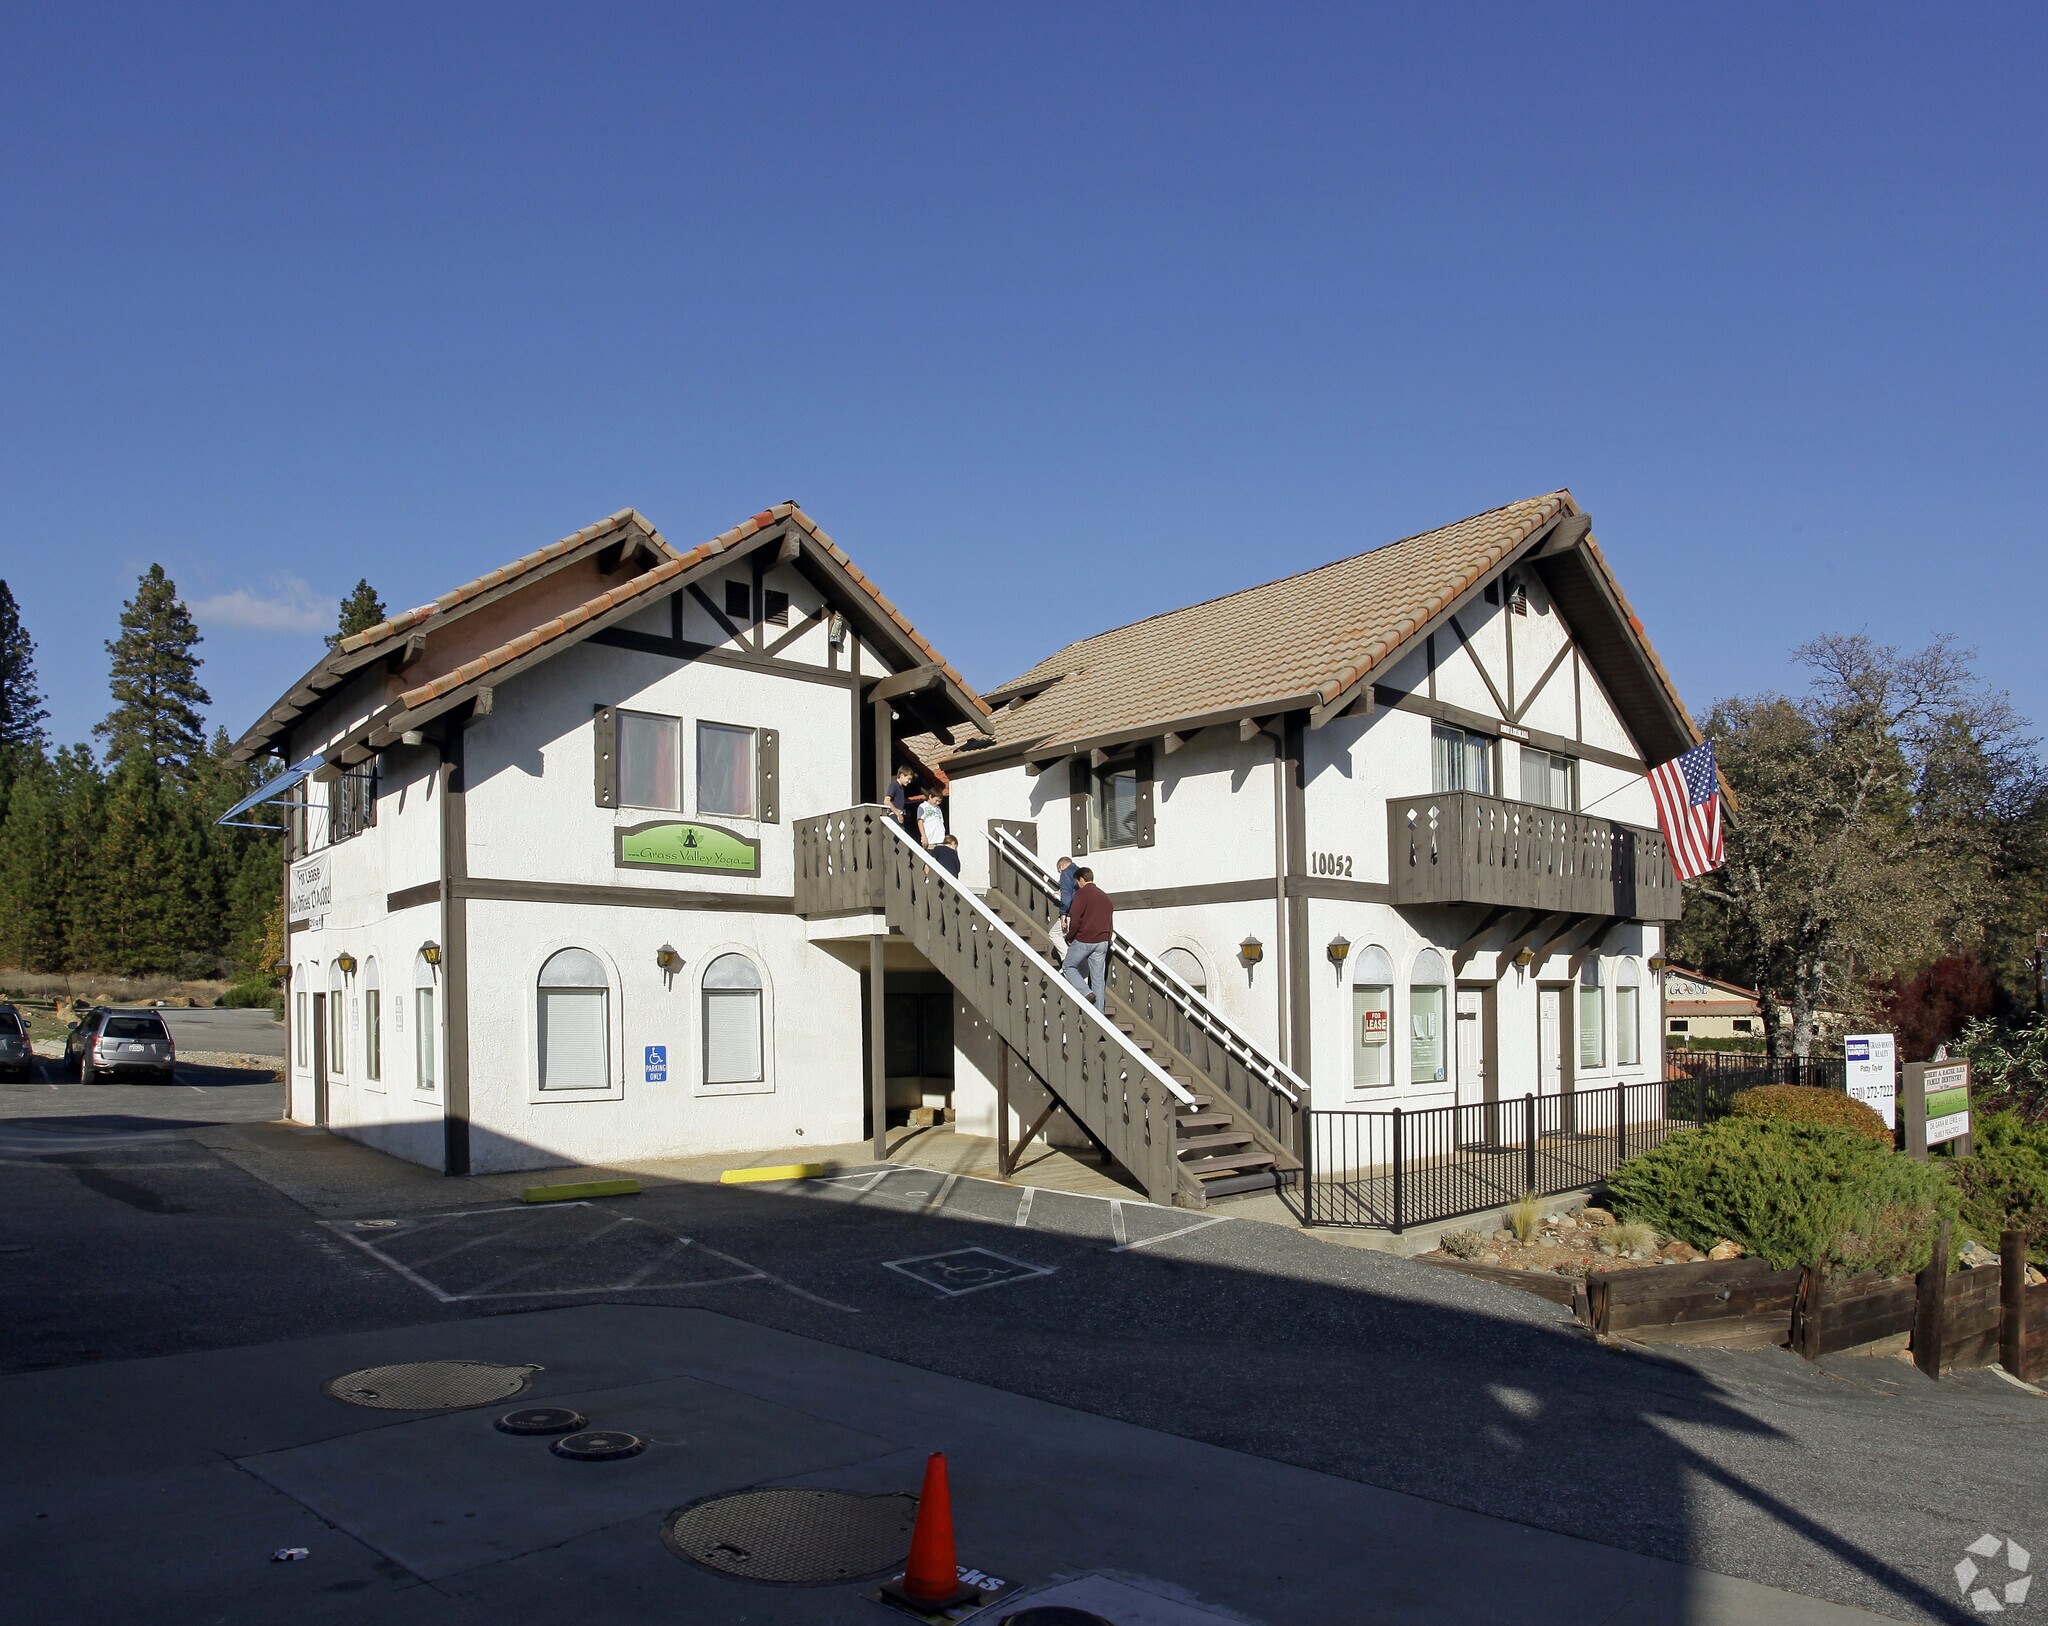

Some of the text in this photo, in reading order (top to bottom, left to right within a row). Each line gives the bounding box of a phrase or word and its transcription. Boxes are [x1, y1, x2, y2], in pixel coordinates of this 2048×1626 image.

[679, 849, 713, 865] Valley
[714, 852, 740, 867] Yoga
[1311, 851, 1353, 878] 10052
[1366, 1019, 1387, 1030] LEASE
[645, 1064, 667, 1073] PARKING
[649, 1072, 663, 1081] ONLY
[1865, 1084, 1894, 1099] 272-7222
